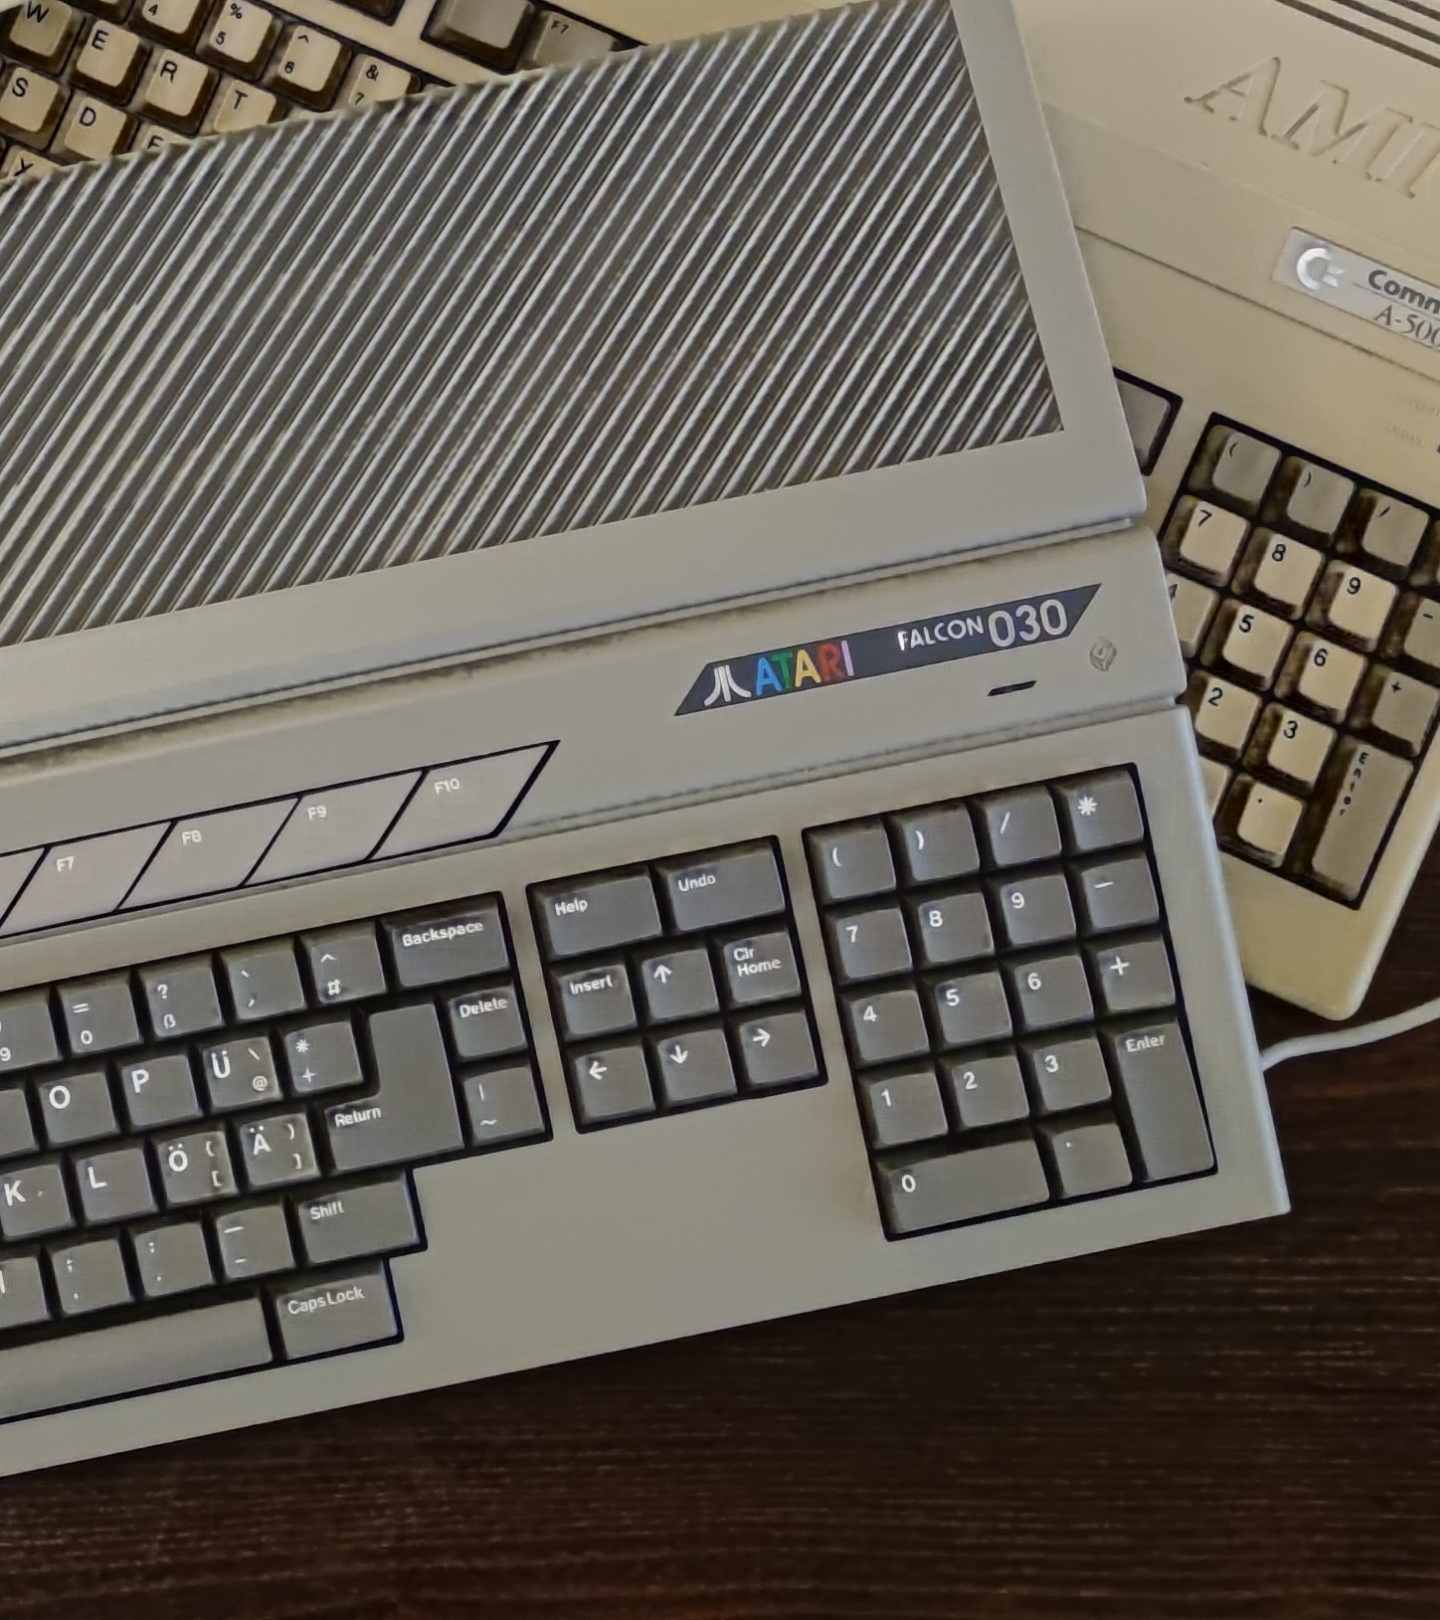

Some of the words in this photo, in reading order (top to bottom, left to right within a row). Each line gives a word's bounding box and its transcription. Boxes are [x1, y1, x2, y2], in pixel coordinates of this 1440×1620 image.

[755, 640, 855, 696] ATARI
[434, 777, 460, 795] F10
[307, 805, 327, 821] F9
[181, 829, 202, 845] F8
[56, 856, 75, 872] F7
[677, 874, 716, 892] Undo
[554, 898, 588, 916] Help
[402, 922, 484, 947] Backspace
[733, 947, 755, 962] Clr
[736, 959, 781, 977] Home
[569, 974, 613, 995] Insert
[459, 998, 508, 1018] Delete
[1125, 1035, 1165, 1053] Enter
[211, 1050, 231, 1079] Ü
[131, 1068, 150, 1094] P
[48, 1085, 71, 1109] O
[334, 1107, 382, 1127] Return
[249, 1125, 272, 1156] Ä
[168, 1143, 189, 1172] Ö
[87, 1166, 107, 1189] L
[3, 1180, 27, 1207] K
[309, 1200, 344, 1220] Shift
[287, 1296, 327, 1315] Caps
[326, 1285, 365, 1305] Lock
